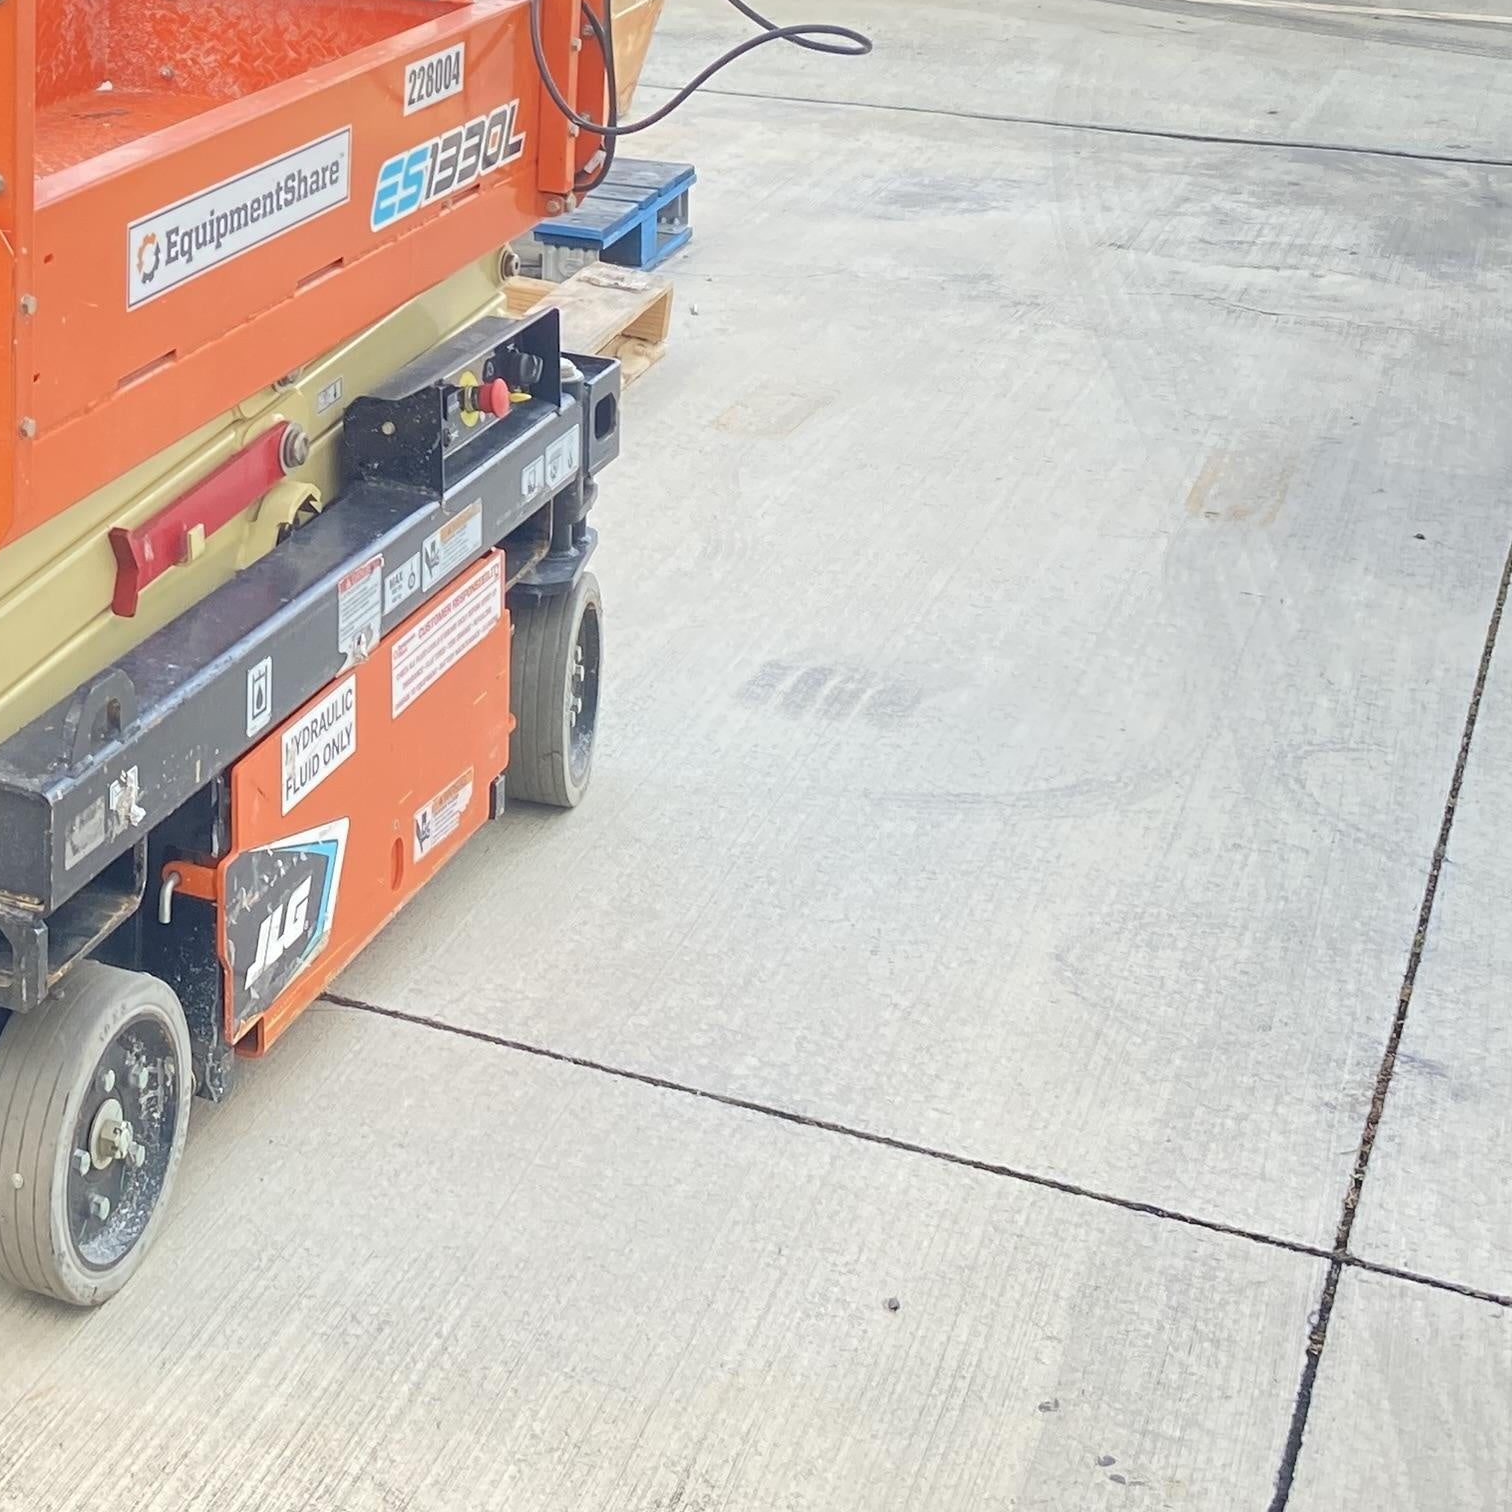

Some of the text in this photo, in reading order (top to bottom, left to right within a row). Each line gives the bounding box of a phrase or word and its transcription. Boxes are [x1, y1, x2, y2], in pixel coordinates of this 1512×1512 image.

[408, 51, 460, 106] 228004
[372, 100, 525, 230] ES1330L
[164, 159, 340, 266] EquipmentShare
[418, 602, 452, 639] CUSTOMER
[285, 688, 353, 766] HYDRAULIC
[286, 722, 353, 801] FLUID ONLY
[244, 874, 312, 991] JLG
